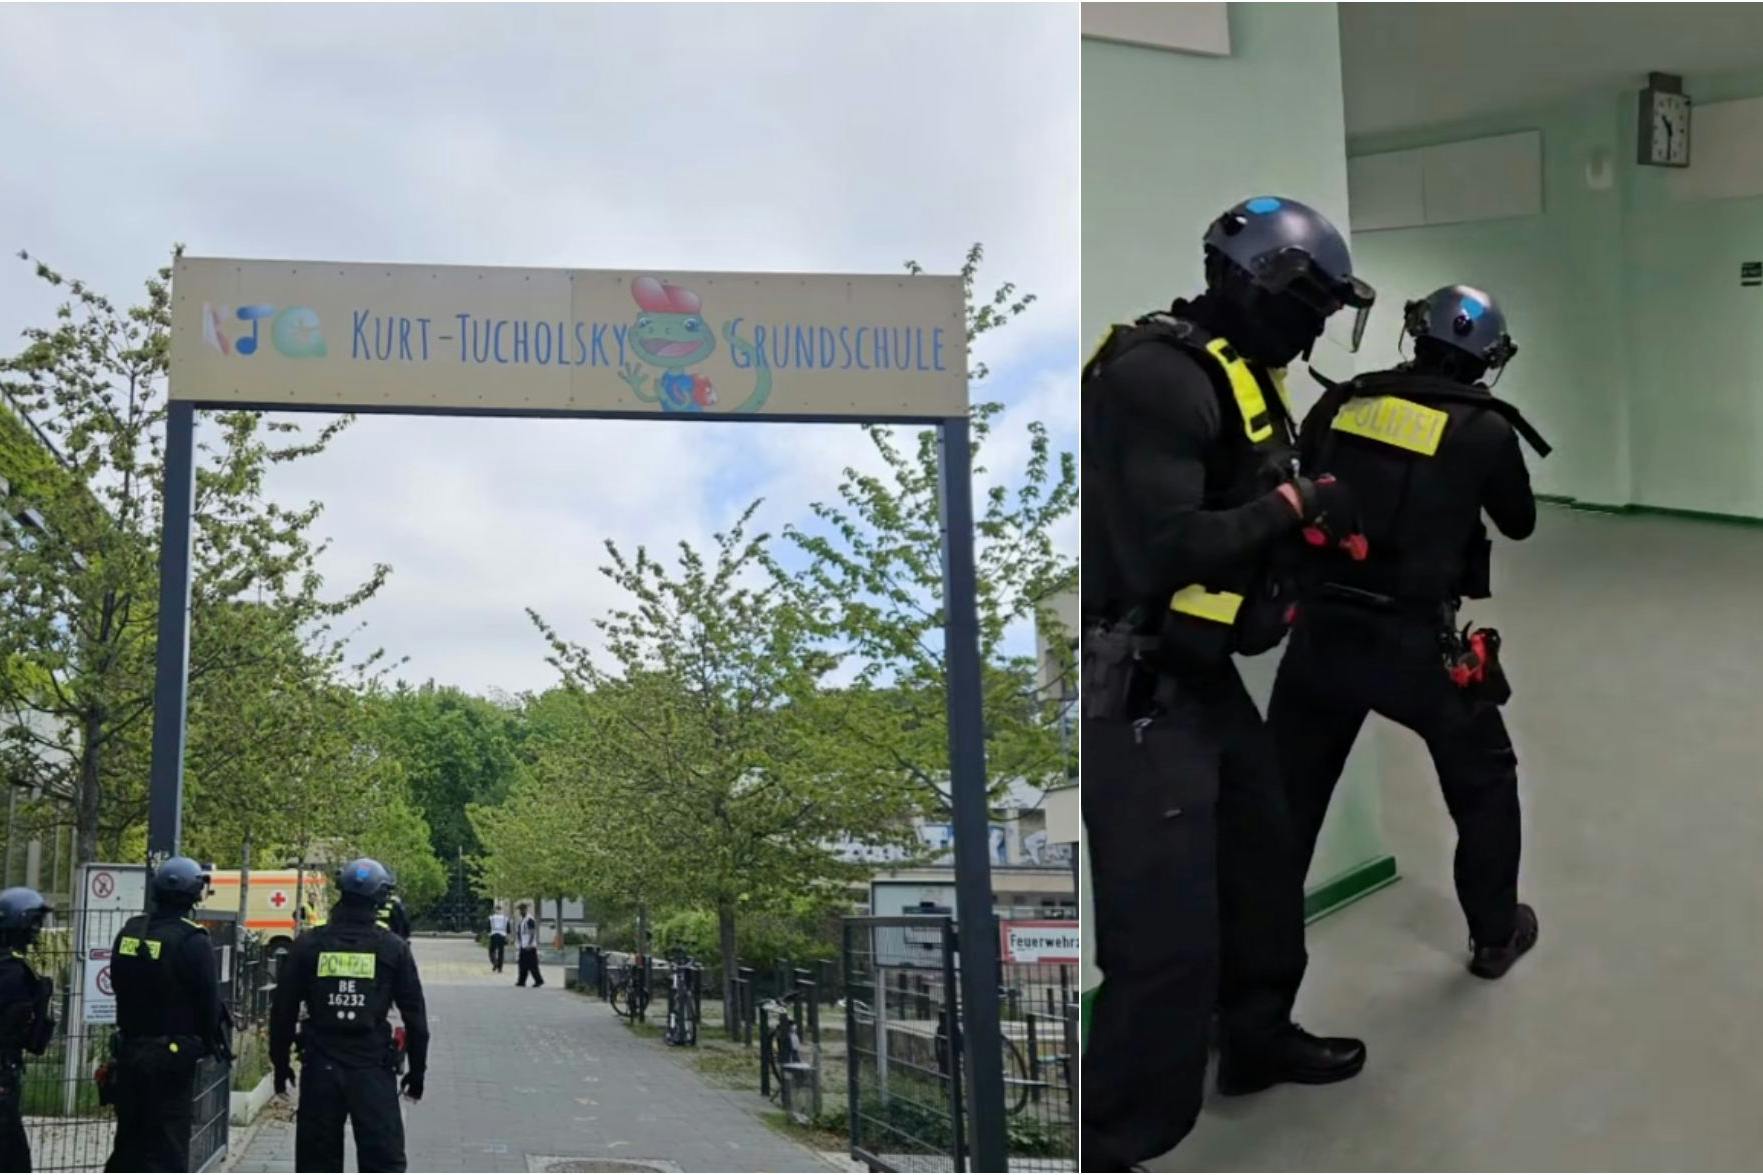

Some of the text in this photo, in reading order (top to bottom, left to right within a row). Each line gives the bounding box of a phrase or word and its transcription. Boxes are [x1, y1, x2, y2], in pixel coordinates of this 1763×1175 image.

[729, 317, 945, 371] GRUNDSCHULE
[339, 980, 356, 993] BE
[328, 993, 366, 1007] 16232
